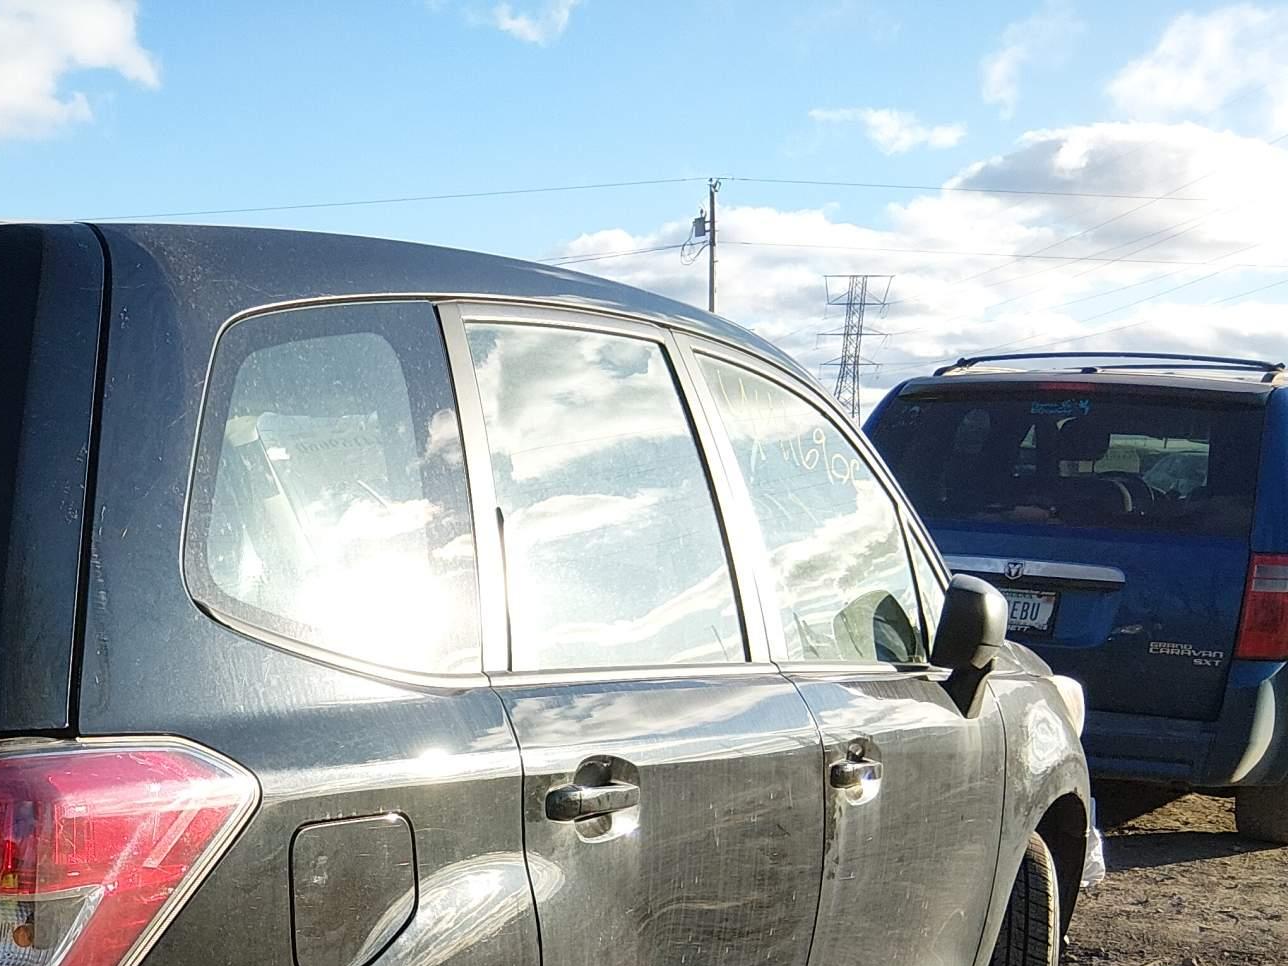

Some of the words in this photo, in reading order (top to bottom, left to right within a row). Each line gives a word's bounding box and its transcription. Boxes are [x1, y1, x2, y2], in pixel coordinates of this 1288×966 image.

[1149, 641, 1193, 650] GRAND
[1148, 647, 1225, 659] CARAVAN
[1193, 658, 1223, 667] SXT
